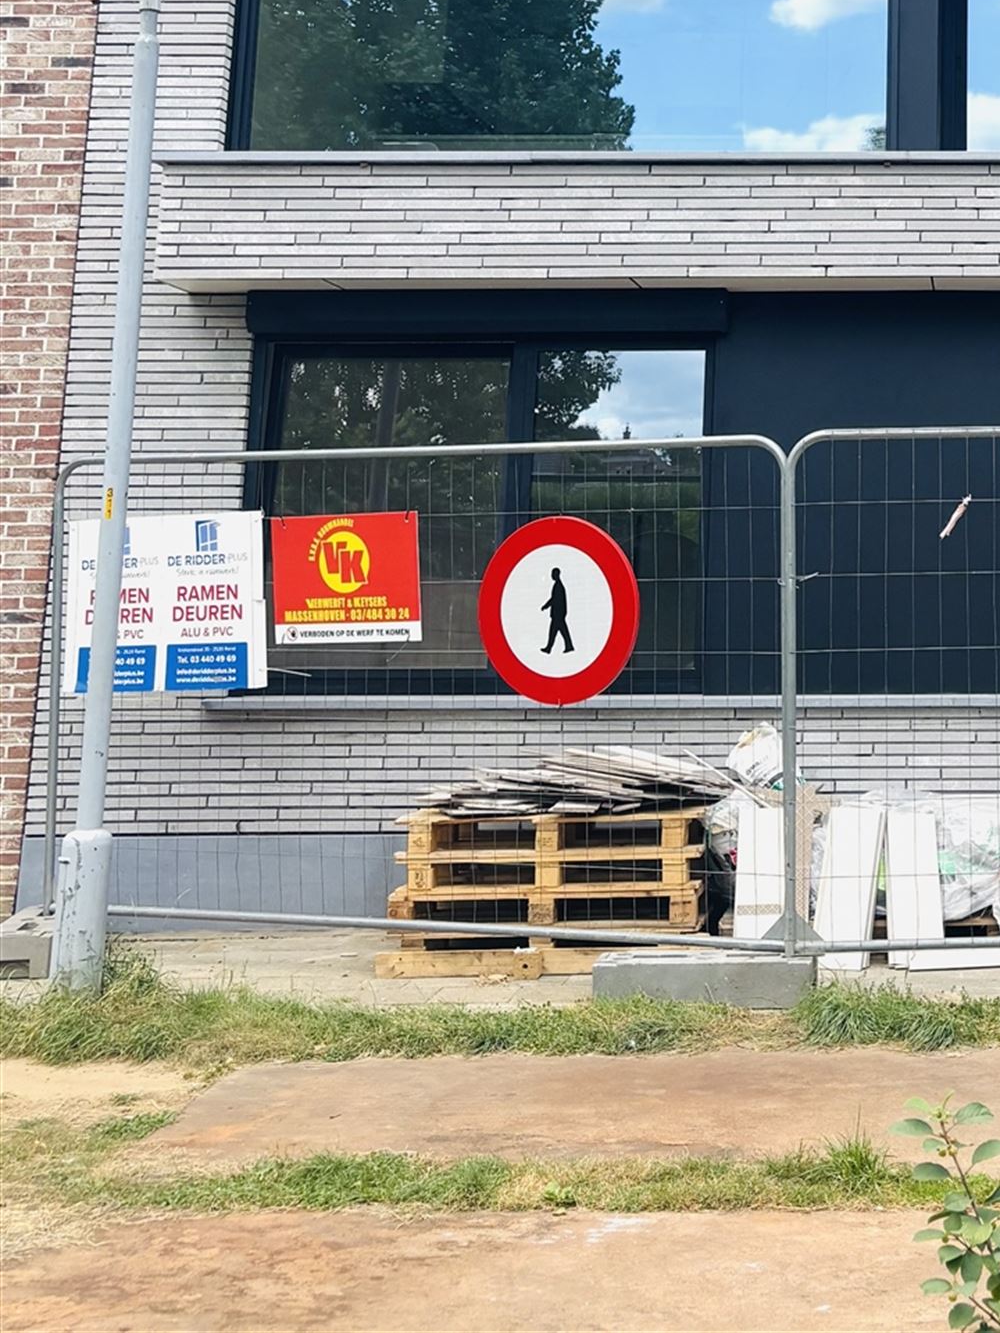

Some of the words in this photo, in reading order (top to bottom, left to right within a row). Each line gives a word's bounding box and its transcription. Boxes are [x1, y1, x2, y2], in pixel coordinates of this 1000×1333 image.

[168, 555, 182, 567] DE
[185, 553, 226, 566] RIDDER
[320, 540, 369, 585] VK
[177, 584, 239, 602] RAMEN
[85, 607, 153, 625] DREN
[172, 604, 243, 622] DEUREN
[398, 607, 410, 619] 24
[123, 629, 144, 640] PVC
[181, 627, 201, 638] ALU
[203, 627, 209, 637] &
[212, 626, 233, 637] PVC
[300, 629, 334, 638] VERBODEN
[336, 628, 345, 637] OP
[385, 628, 410, 637] KOMEN
[215, 654, 225, 663] 49
